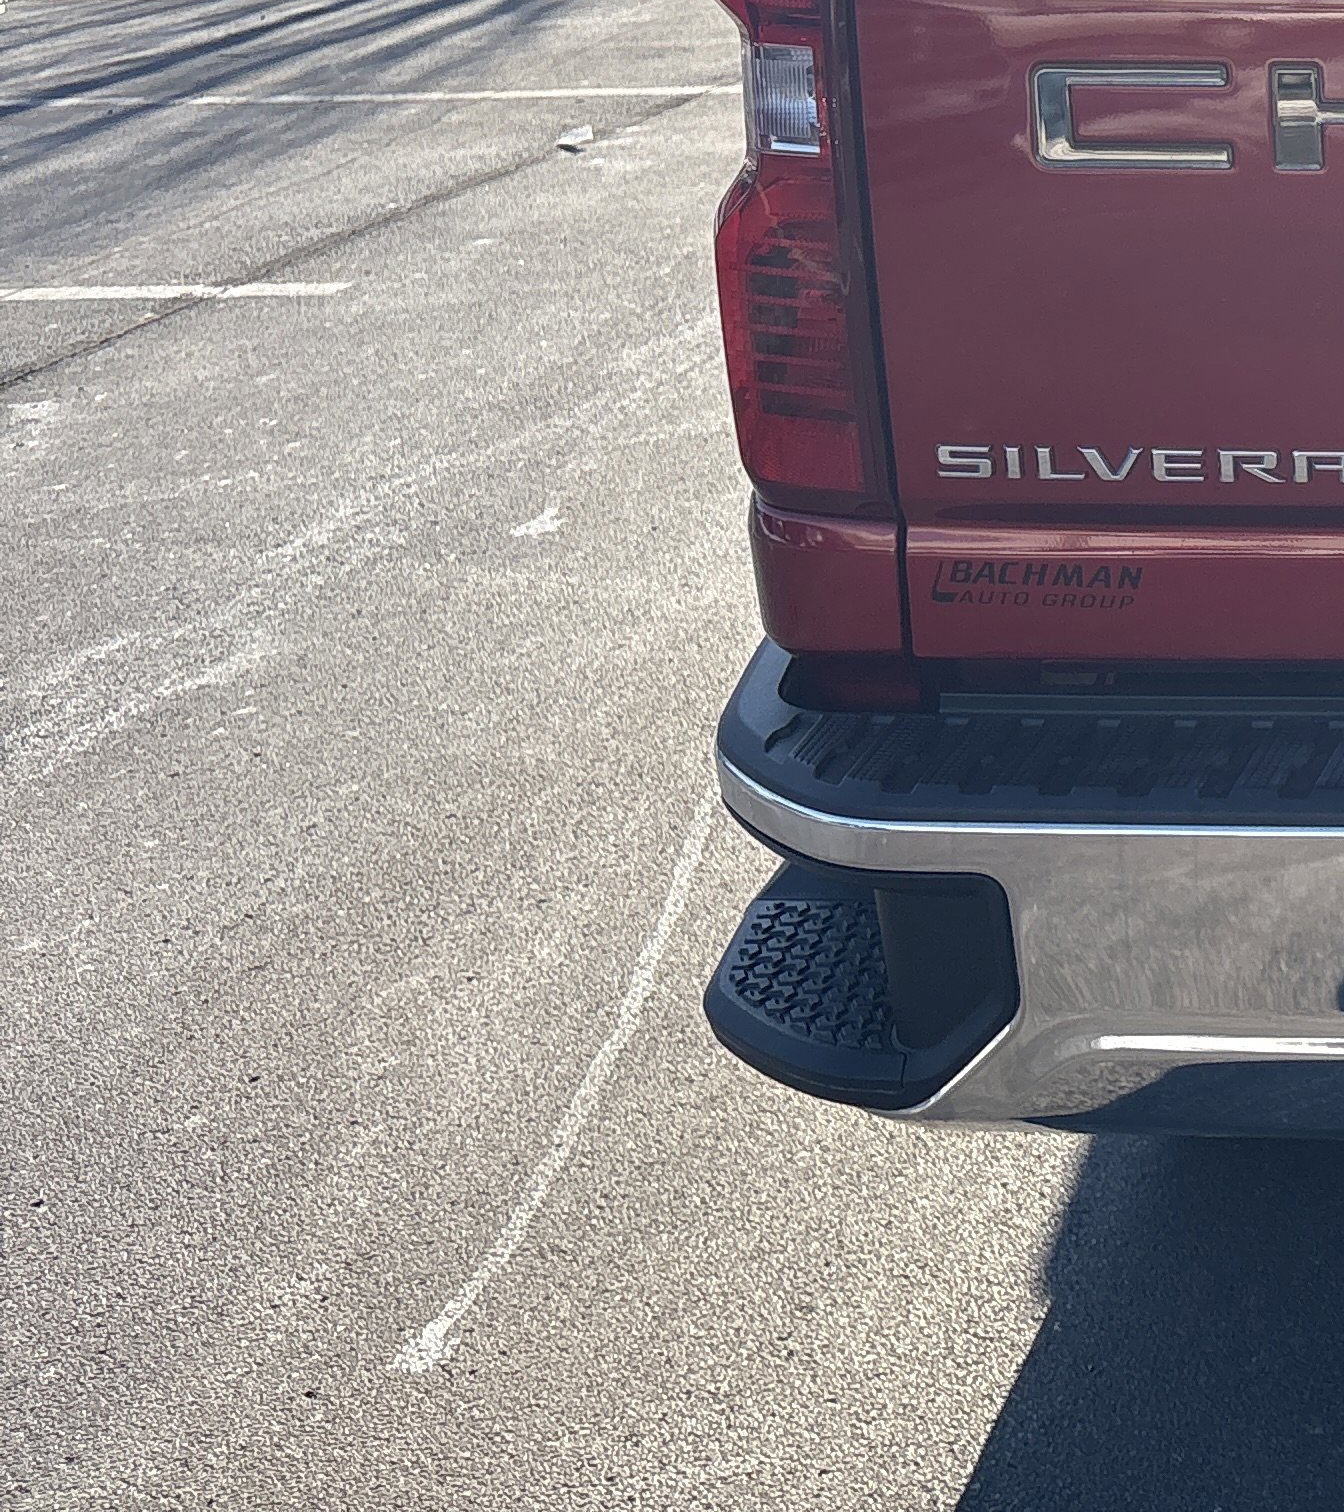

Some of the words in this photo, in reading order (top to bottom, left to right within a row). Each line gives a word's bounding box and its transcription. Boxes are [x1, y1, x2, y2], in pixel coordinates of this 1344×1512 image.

[950, 559, 1144, 591] BACHMAN
[959, 589, 1030, 607] AUTO
[1041, 592, 1136, 610] GROUP
